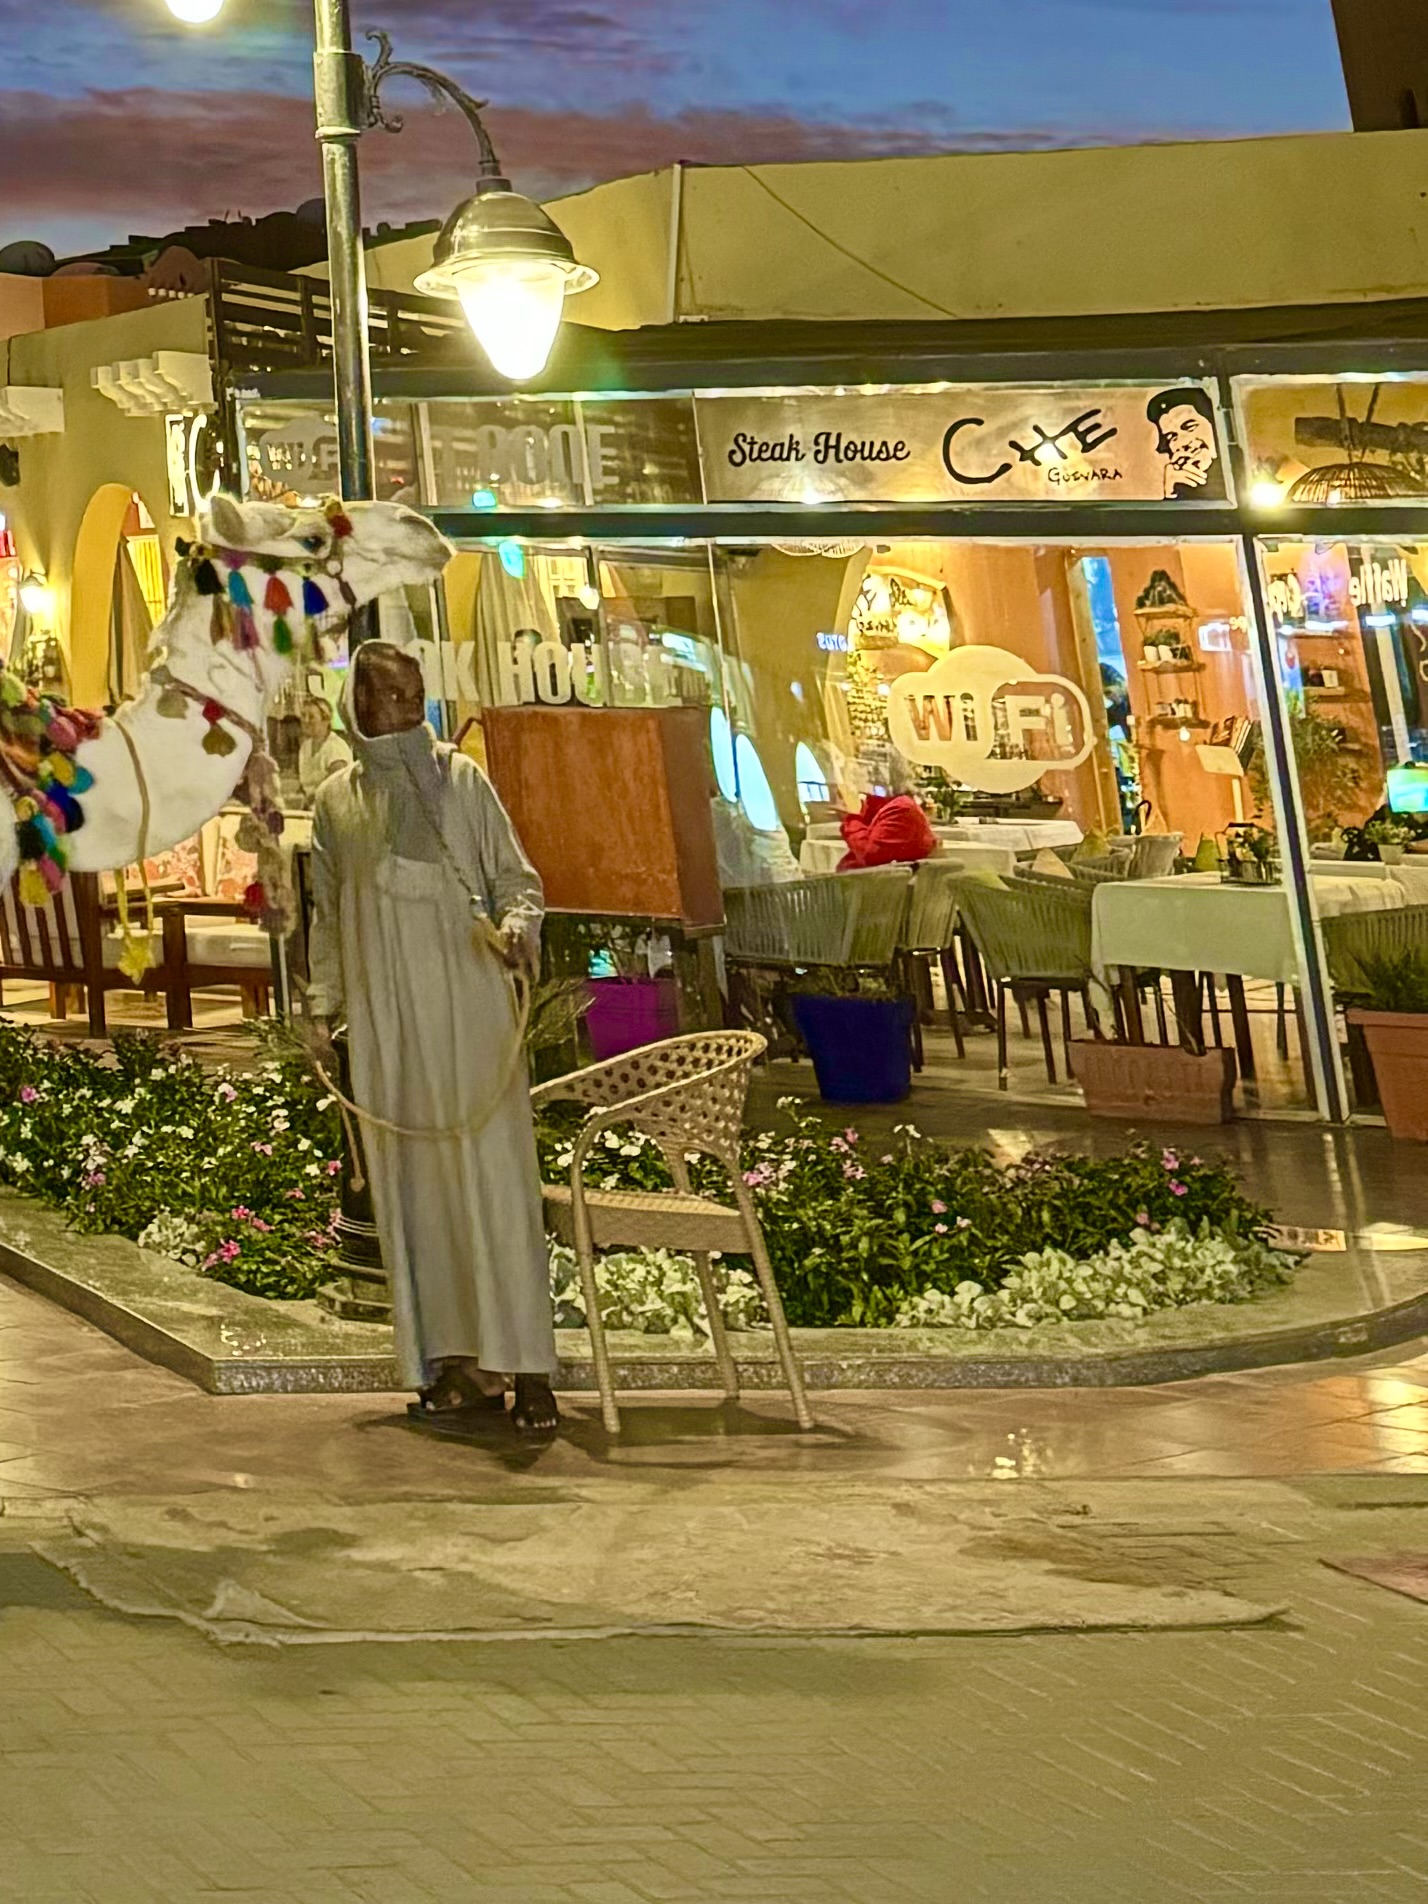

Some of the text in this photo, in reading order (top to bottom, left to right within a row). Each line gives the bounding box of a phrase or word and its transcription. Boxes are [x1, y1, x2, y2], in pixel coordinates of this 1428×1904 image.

[727, 431, 911, 467] Steak House
[942, 408, 1118, 484] CHE
